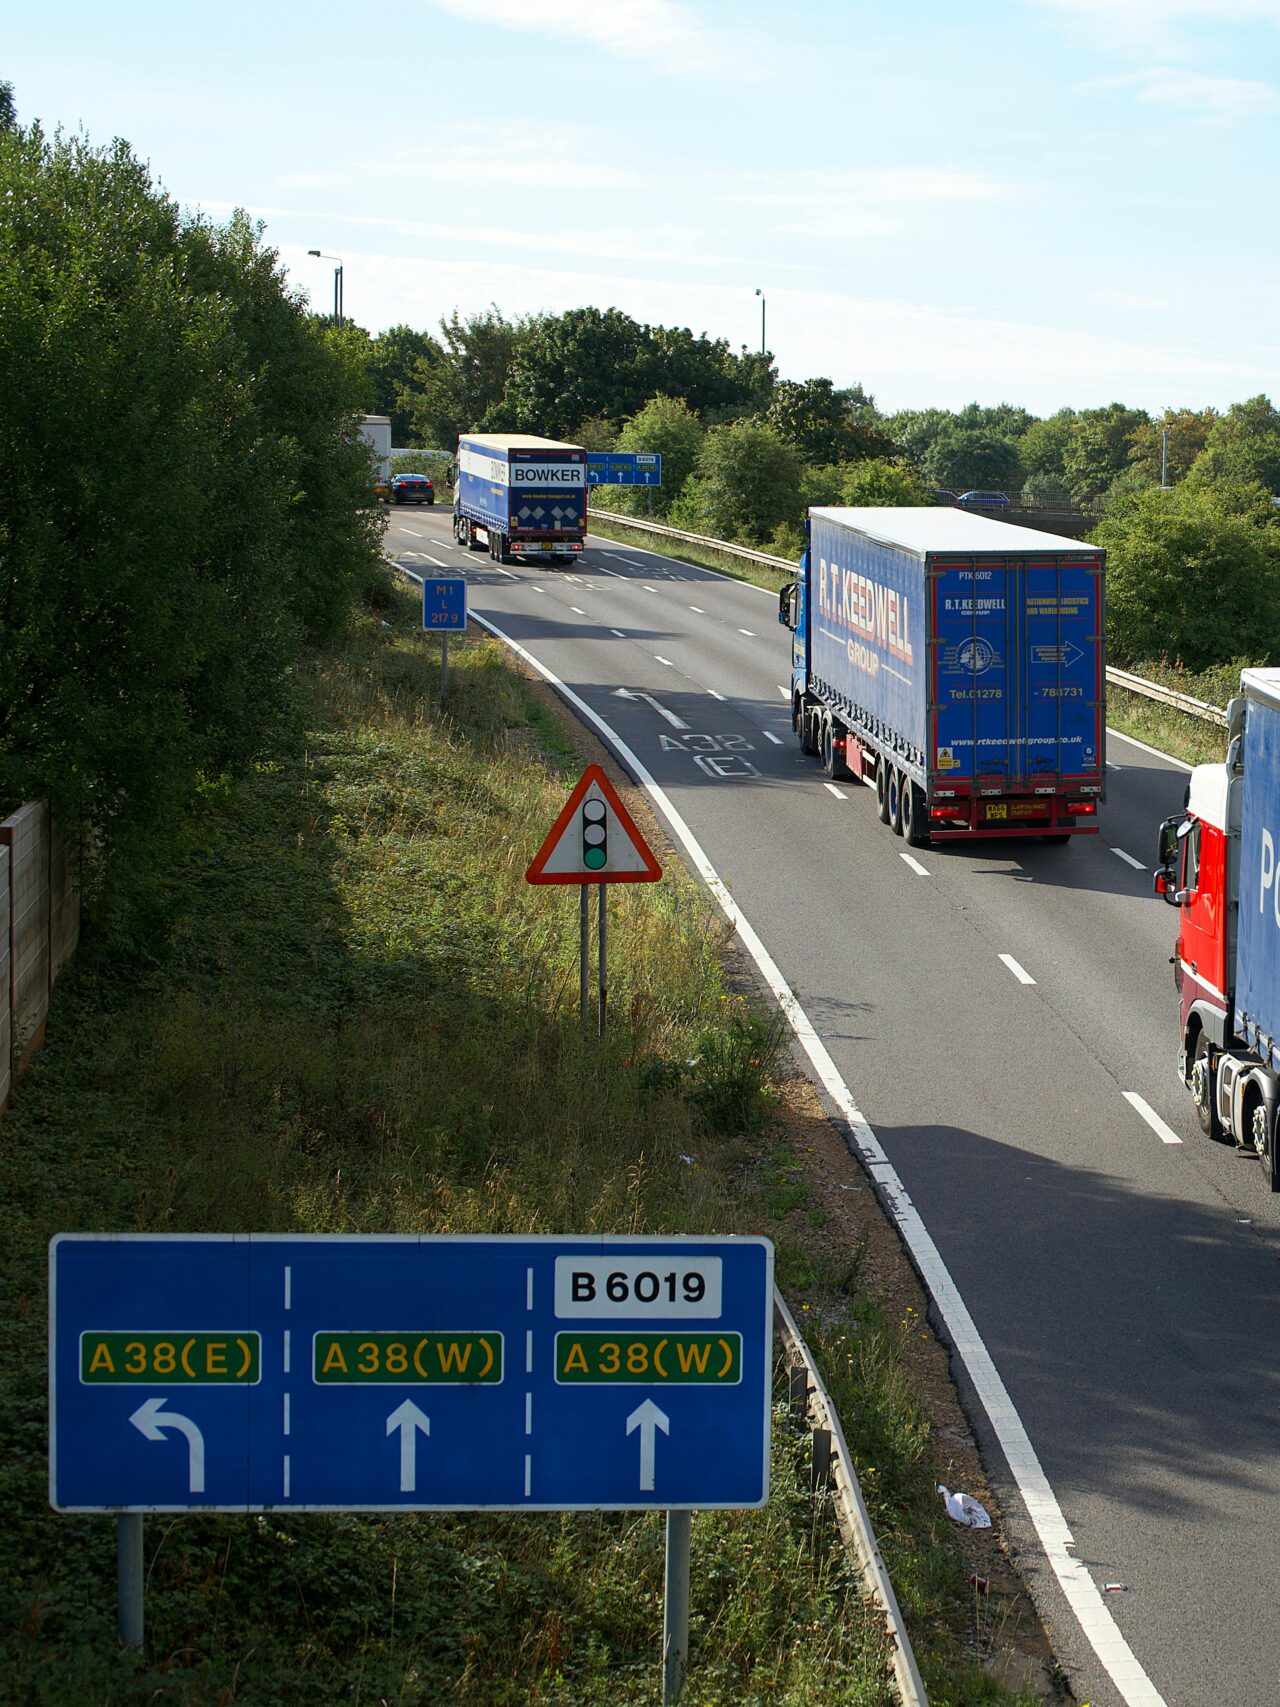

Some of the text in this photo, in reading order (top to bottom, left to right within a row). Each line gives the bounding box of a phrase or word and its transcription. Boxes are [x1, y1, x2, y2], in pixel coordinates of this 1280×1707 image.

[515, 468, 580, 482] BOWKER
[959, 571, 973, 580] PTK
[847, 638, 879, 675] GROUP
[659, 734, 757, 752] A38
